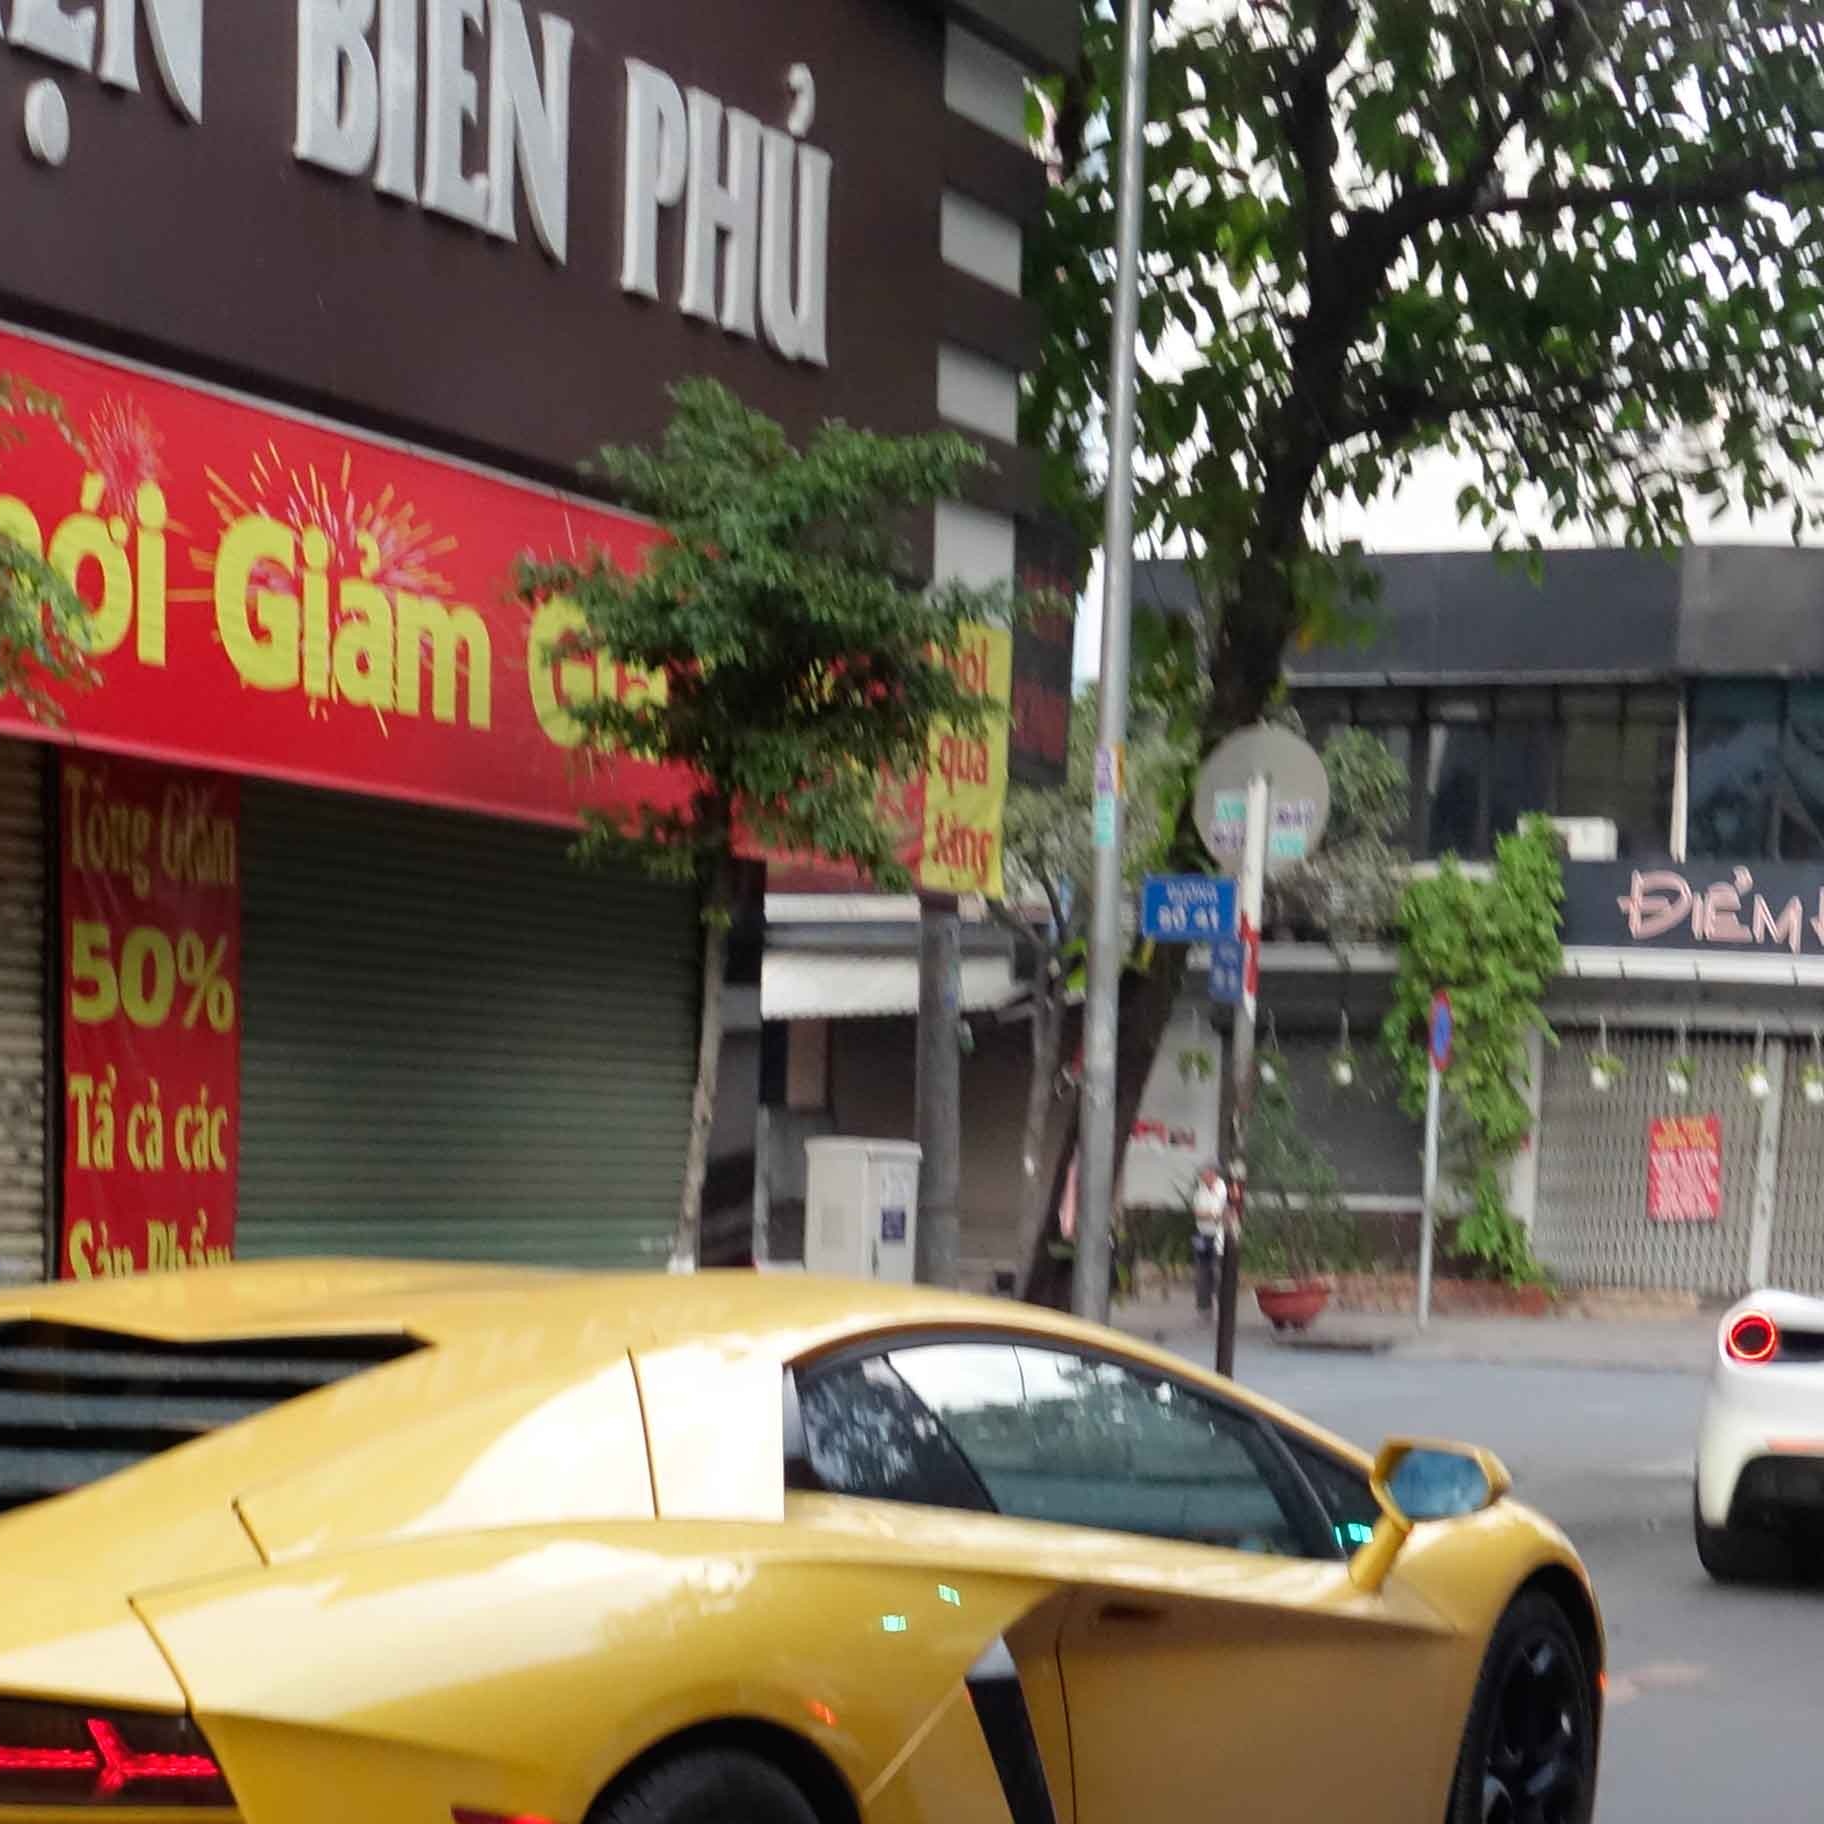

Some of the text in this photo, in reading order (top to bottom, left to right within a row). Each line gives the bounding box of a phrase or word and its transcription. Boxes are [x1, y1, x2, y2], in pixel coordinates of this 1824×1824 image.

[619, 57, 833, 367] PHỦ
[213, 512, 492, 732] Giảm
[71, 919, 236, 1034] 50%
[127, 1077, 165, 1173] cả
[175, 1084, 229, 1173] các
